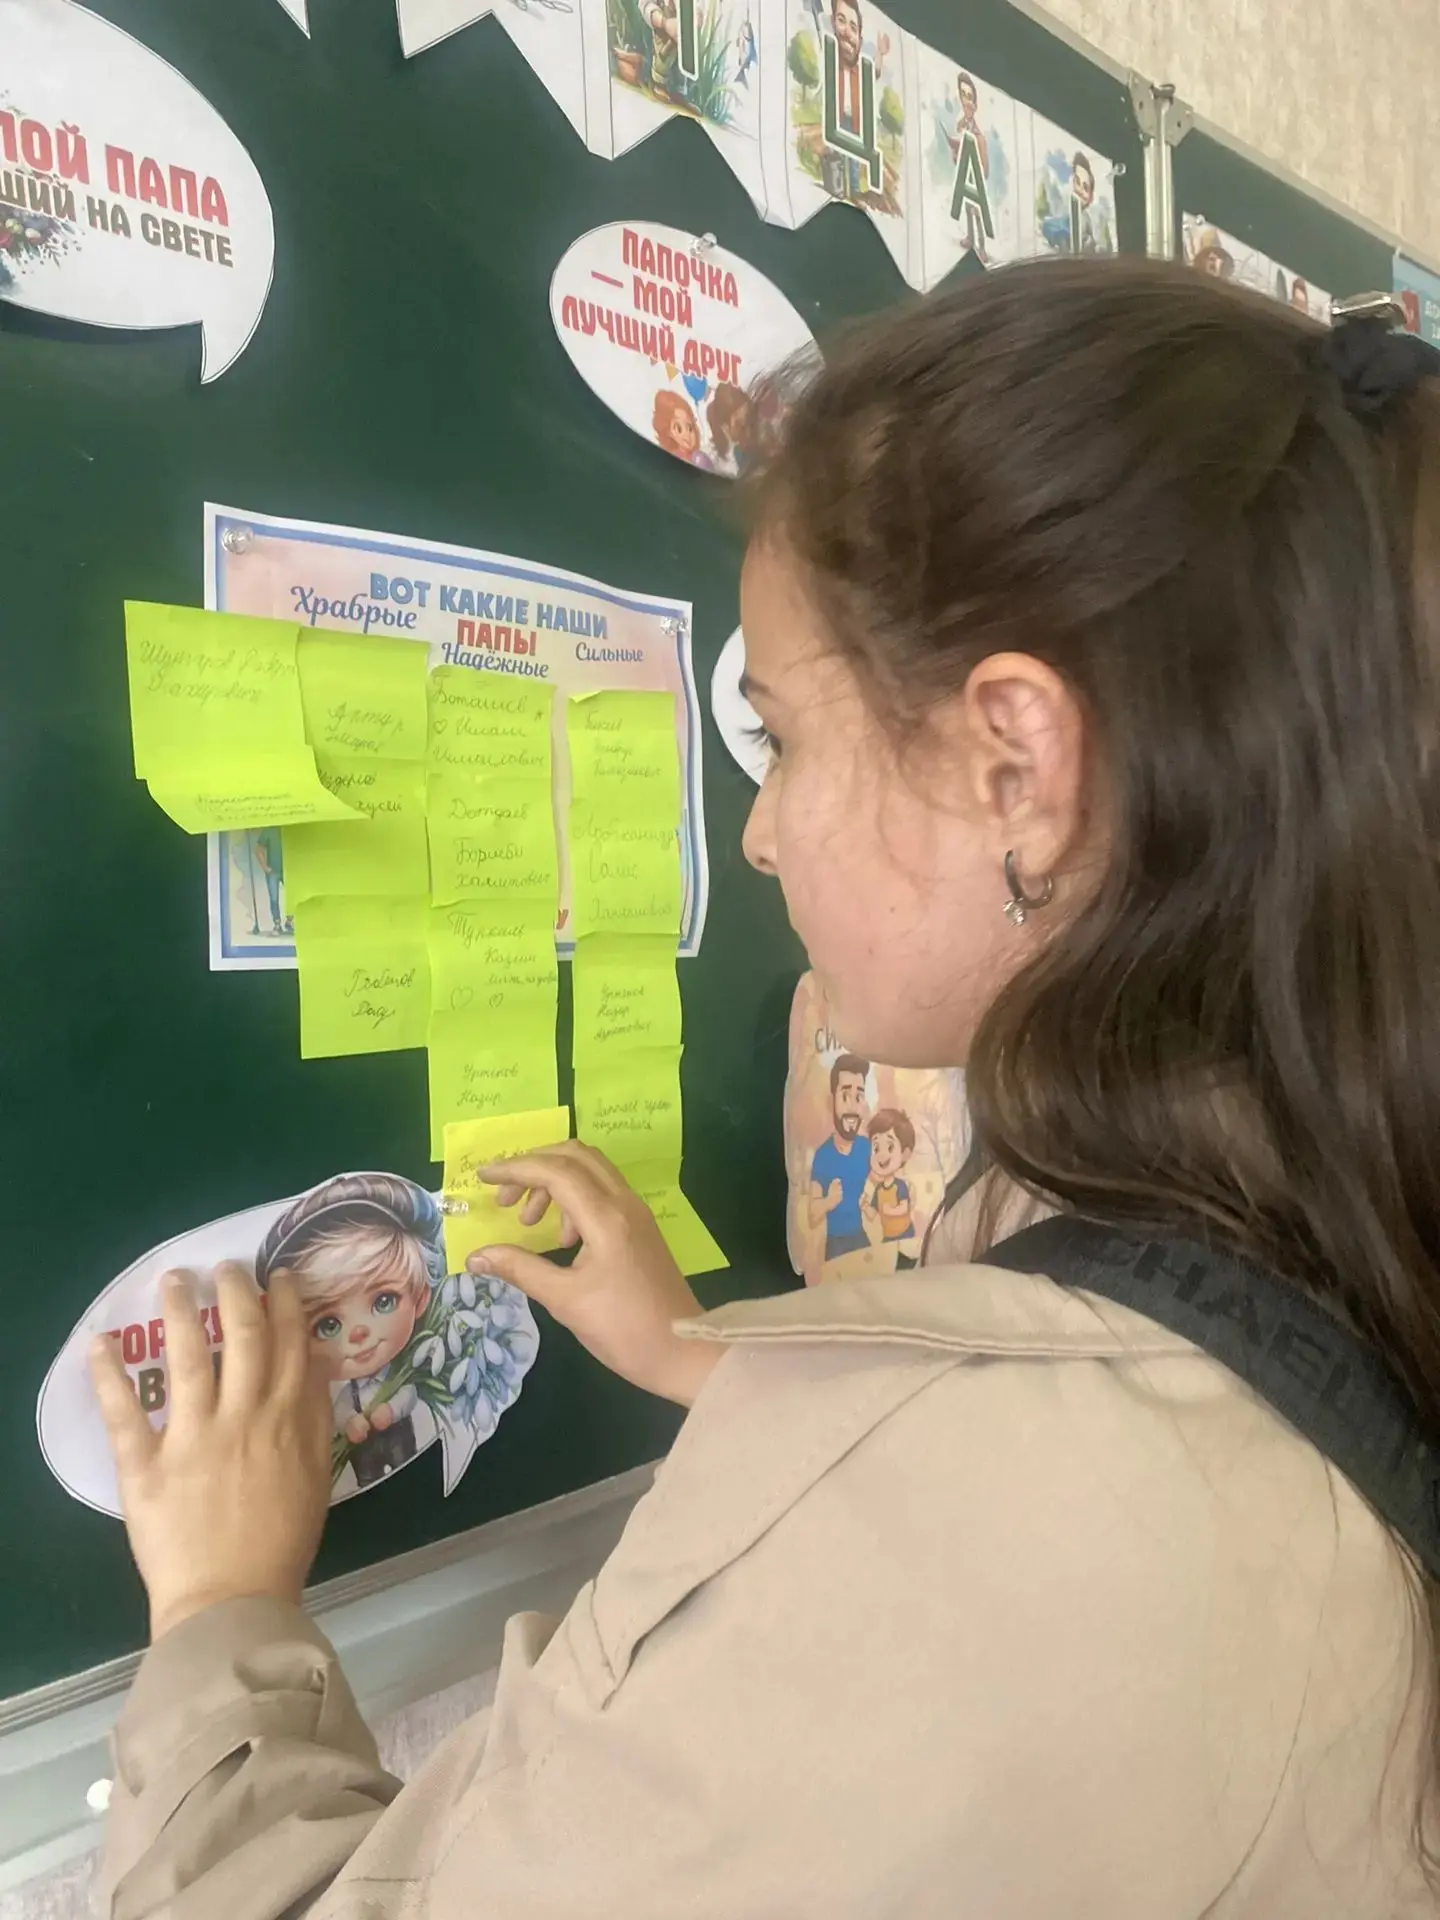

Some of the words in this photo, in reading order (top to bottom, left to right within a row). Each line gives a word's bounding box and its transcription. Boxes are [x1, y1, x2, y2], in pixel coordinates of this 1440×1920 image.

[105, 142, 229, 227] ПАПА
[86, 195, 132, 240] НА
[140, 212, 234, 269] СВЕТЕ
[622, 227, 740, 308] ПАПОЧКА
[632, 273, 693, 329] МОЙ
[561, 294, 676, 366] ЛУЧШИЙ
[682, 338, 743, 388] ДРУГ
[290, 585, 418, 635] Храбрые
[370, 572, 432, 608] ВОТ
[439, 584, 530, 625] КАКИЕ
[536, 602, 609, 640] НАШИ
[441, 641, 550, 679] Надёжные
[457, 618, 538, 657] ПАПЫ
[575, 641, 644, 665] Сильные
